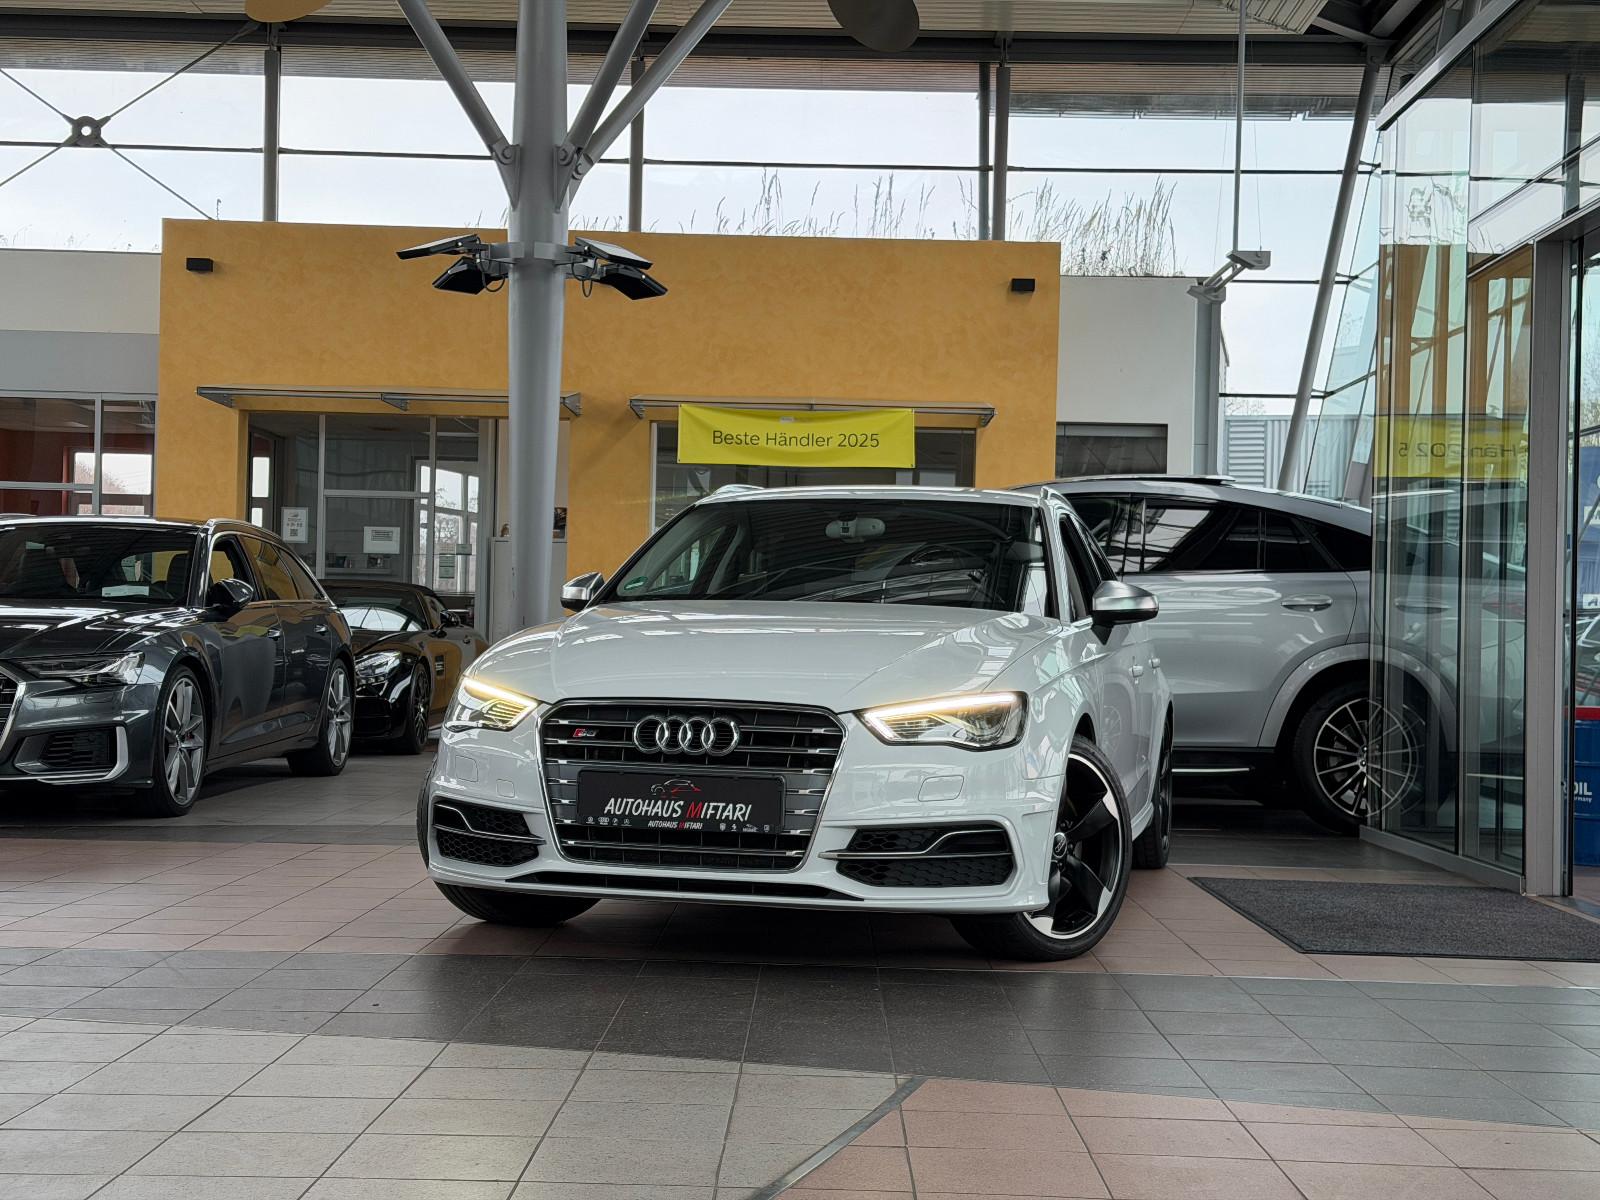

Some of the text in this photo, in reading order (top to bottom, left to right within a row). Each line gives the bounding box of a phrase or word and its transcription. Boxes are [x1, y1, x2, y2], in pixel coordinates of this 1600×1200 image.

[712, 430, 880, 448] Beste Händler 2025
[604, 797, 753, 822] AUTOHAUS MIFTARI
[647, 820, 704, 830] AUTOHAUS MIFTARI
